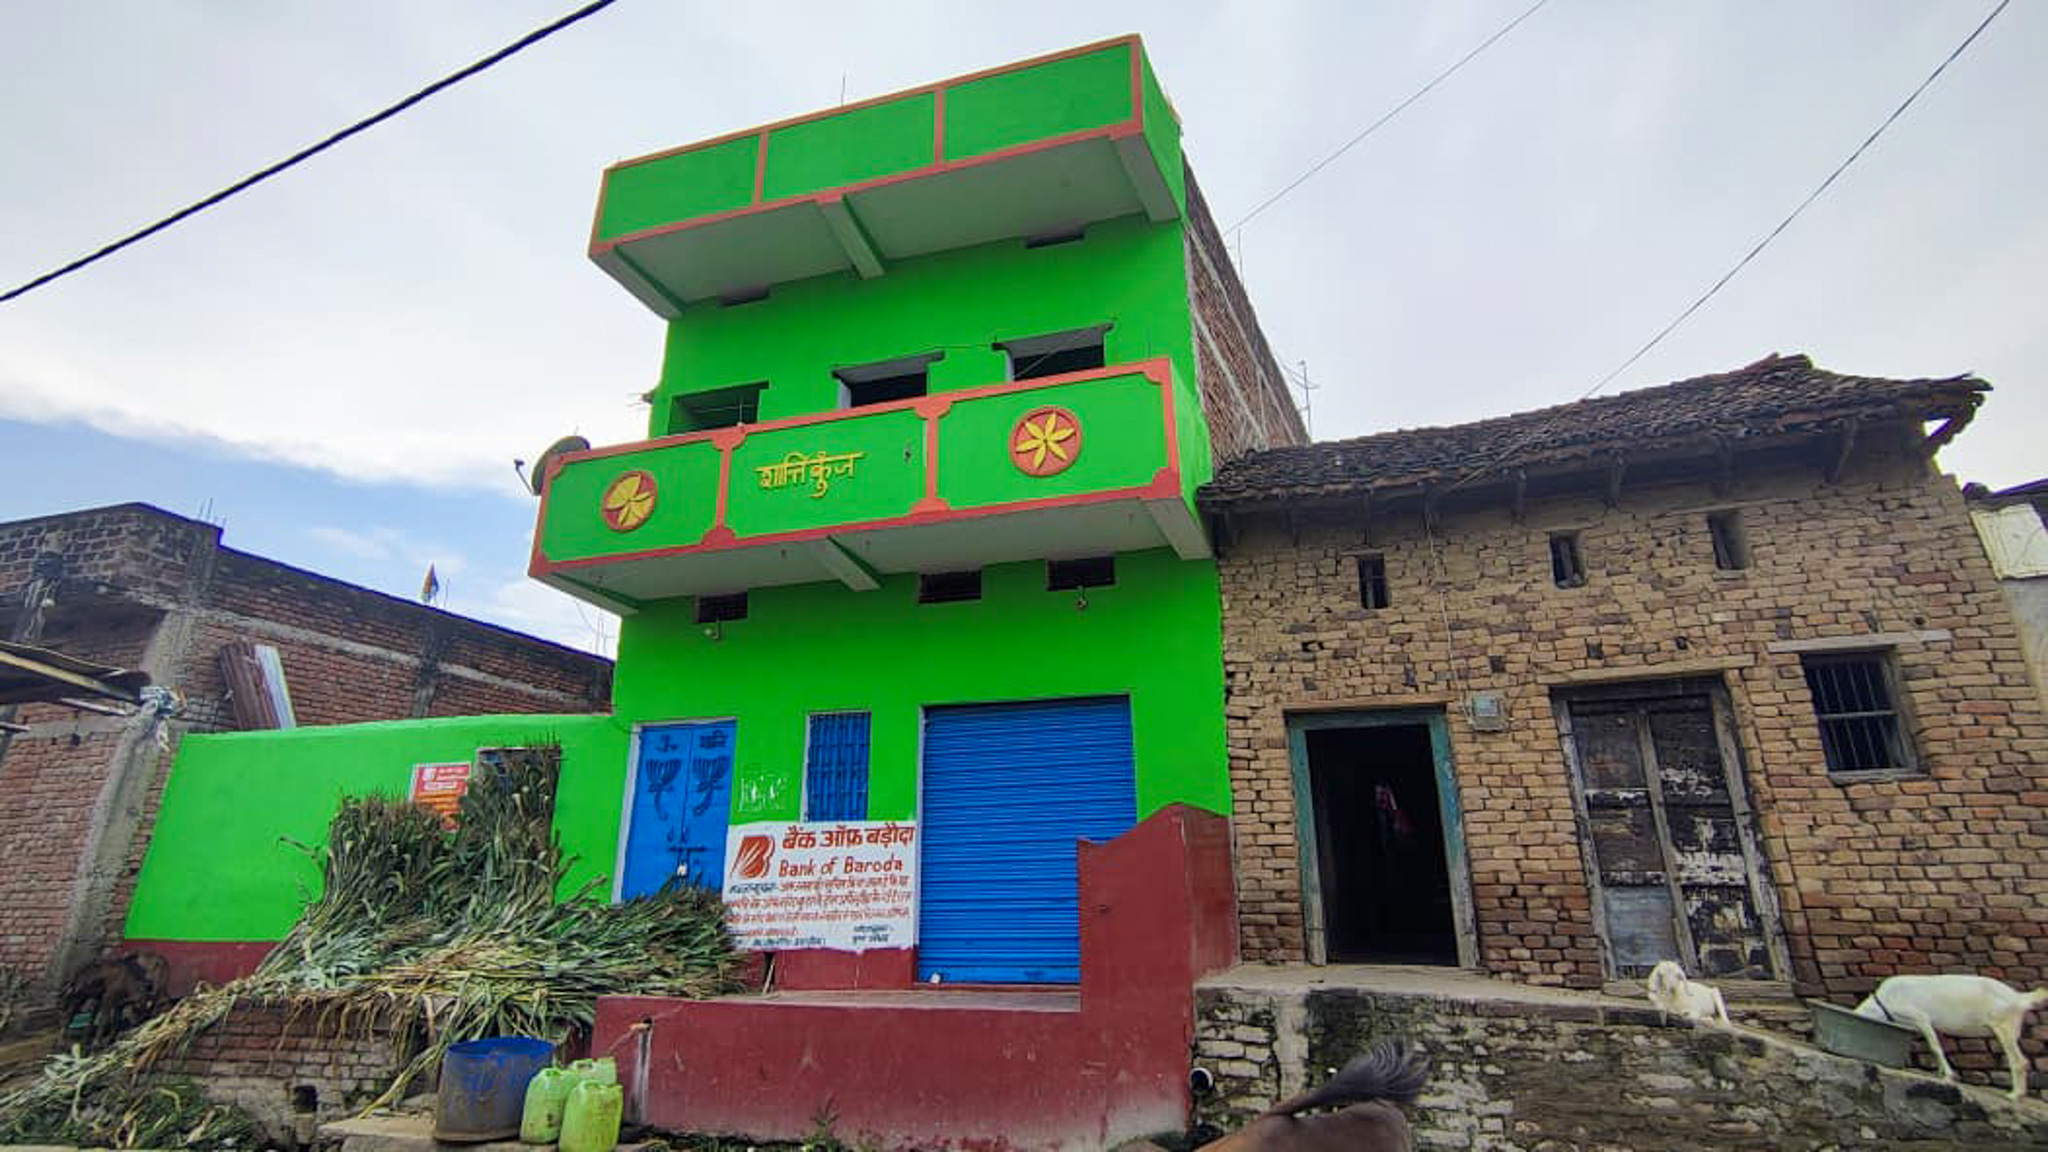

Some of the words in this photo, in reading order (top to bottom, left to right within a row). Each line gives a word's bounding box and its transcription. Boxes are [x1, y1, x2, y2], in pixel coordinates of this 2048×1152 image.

[782, 825, 816, 849] बैंक
[778, 857, 814, 877] Bank
[820, 856, 839, 875] of
[844, 852, 904, 873] Baroda
